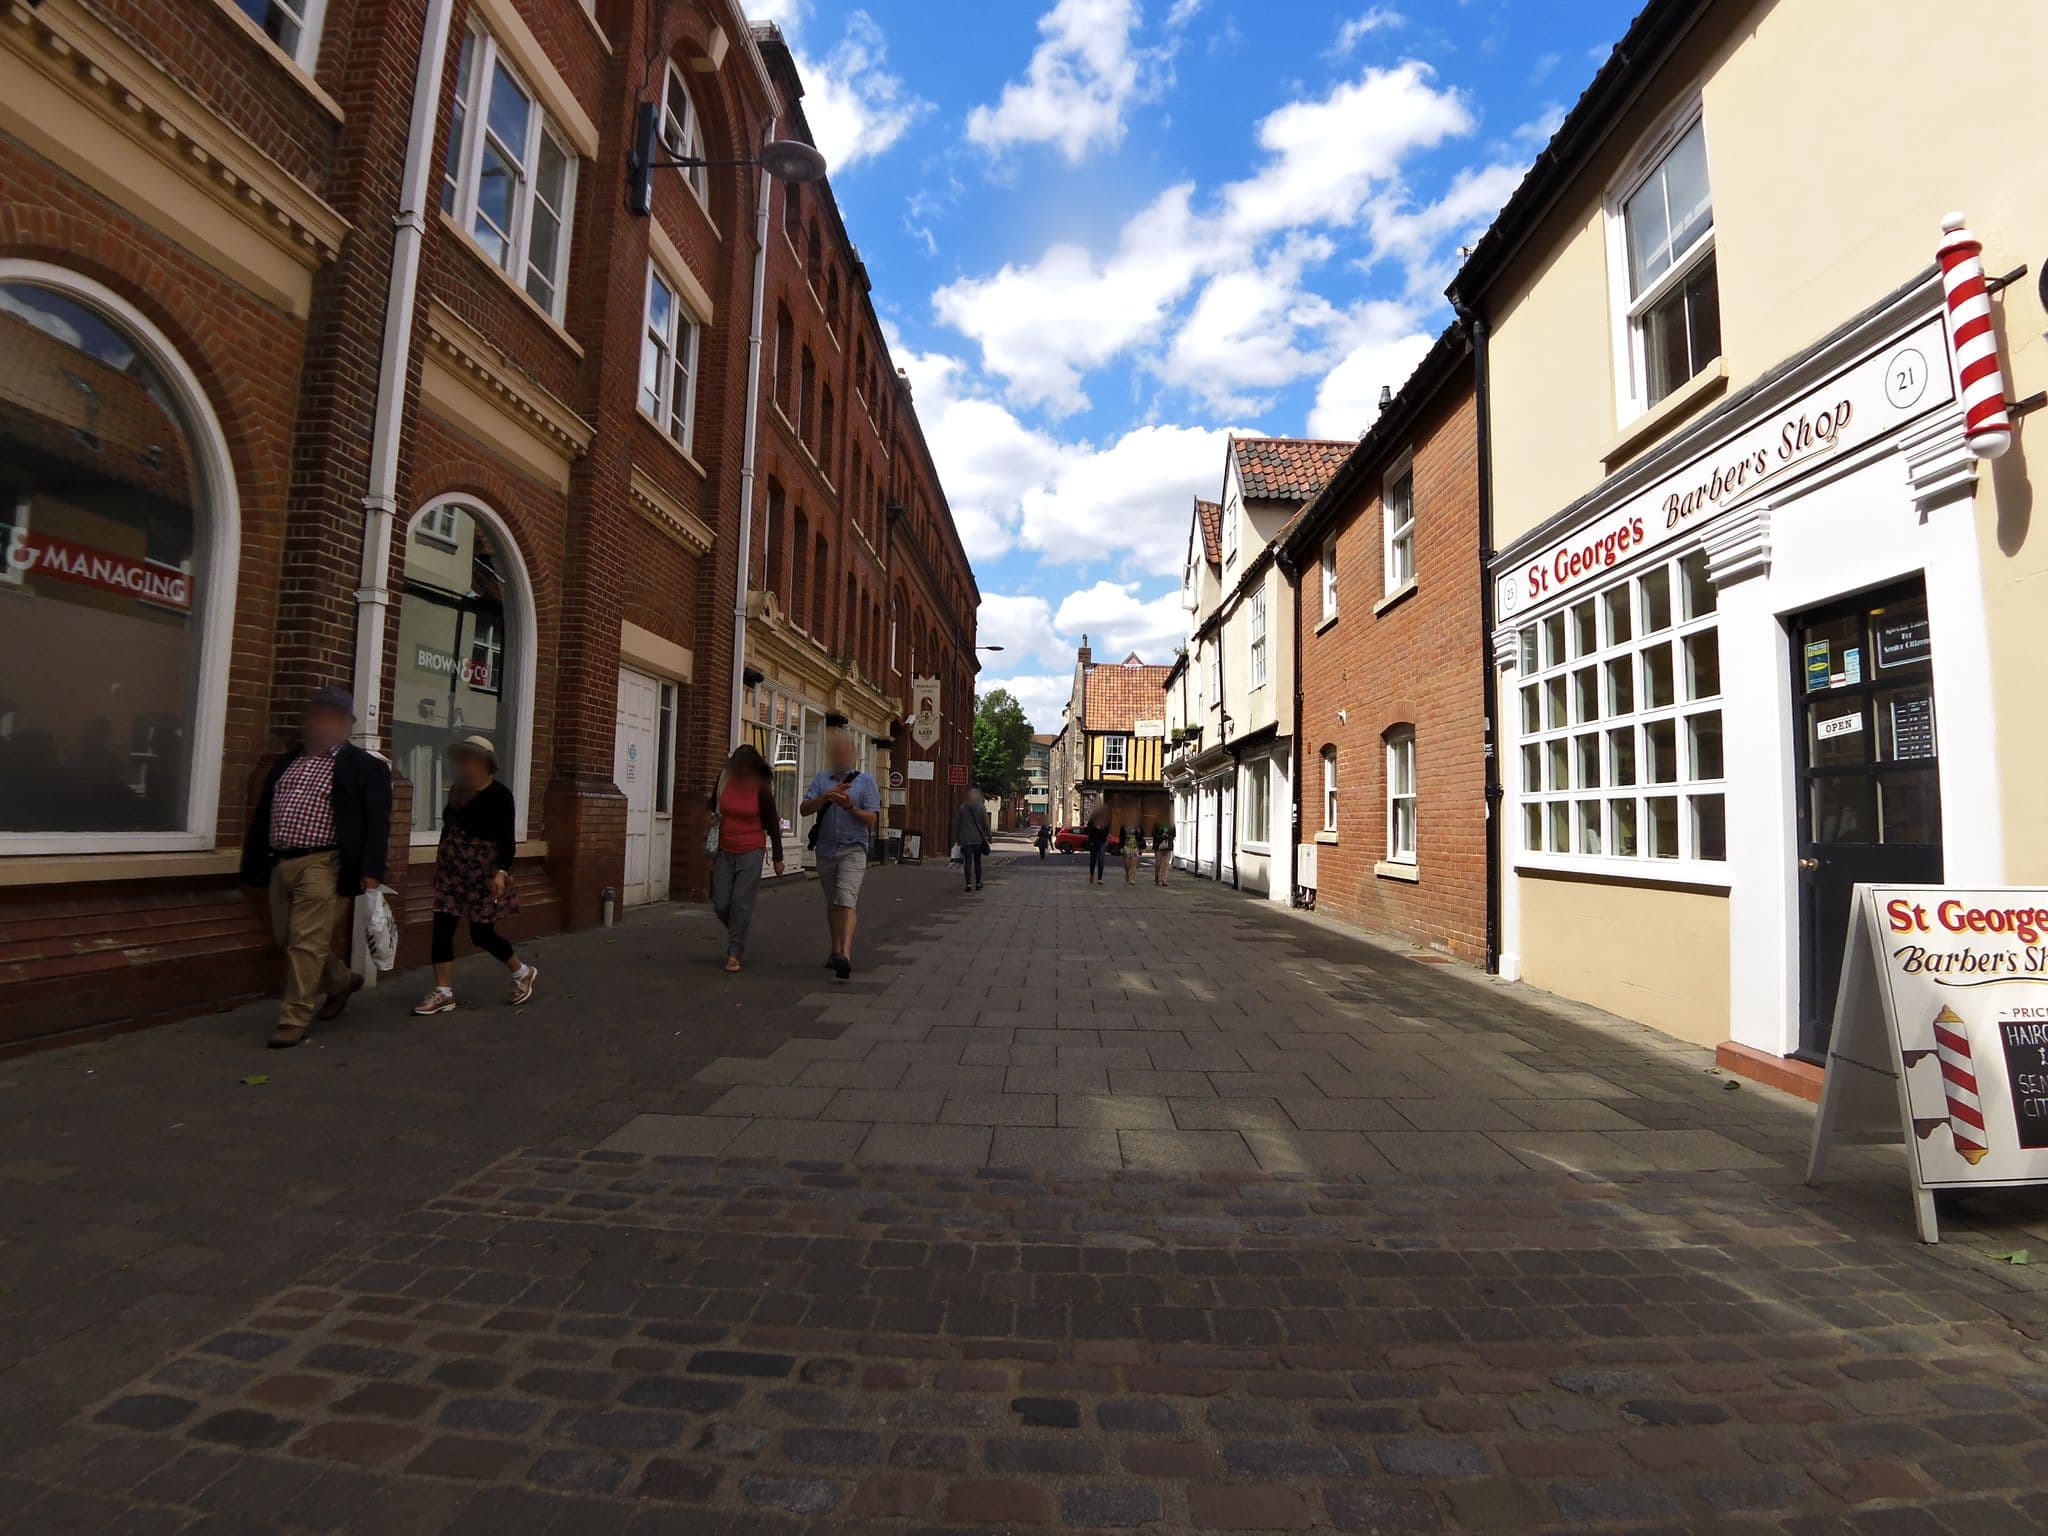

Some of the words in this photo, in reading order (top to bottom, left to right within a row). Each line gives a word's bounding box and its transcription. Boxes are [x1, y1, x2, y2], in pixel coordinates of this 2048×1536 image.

[1896, 366, 1914, 391] 21
[1528, 564, 1549, 599] St
[1554, 516, 1645, 584] George's
[1662, 448, 1768, 529] Barber's
[1778, 399, 1852, 462] Shop
[42, 545, 185, 602] MANAGING
[1825, 718, 1852, 733] OPEN
[1887, 899, 1930, 933] St
[1893, 945, 2018, 974] Barber's
[2012, 1007, 2048, 1018] PRIC
